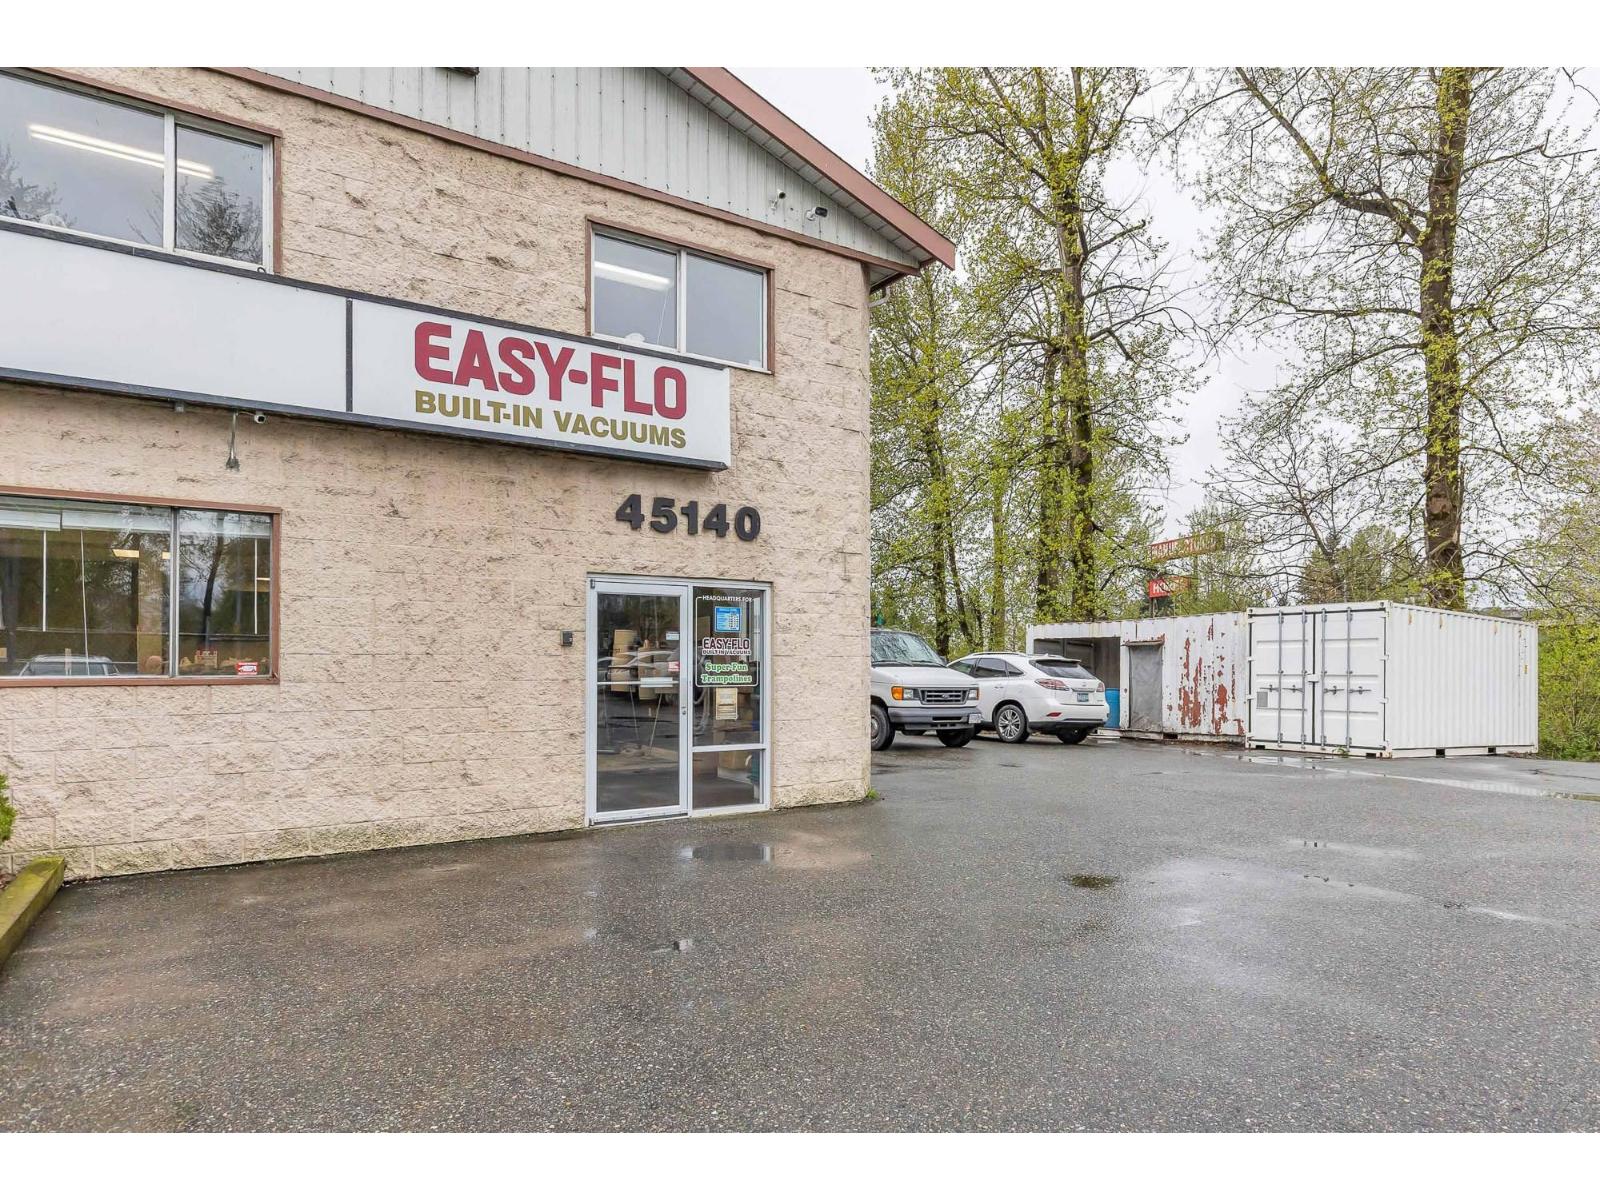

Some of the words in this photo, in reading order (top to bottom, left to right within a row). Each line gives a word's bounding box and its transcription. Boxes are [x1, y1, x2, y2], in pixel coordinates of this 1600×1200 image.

[414, 321, 687, 420] EASY-FLO
[415, 390, 543, 429] BUILT-IN
[553, 410, 686, 449] VACUUMS
[615, 494, 761, 542] 45140
[703, 638, 750, 650] EASY-FLO
[701, 674, 752, 683] Trampolines
